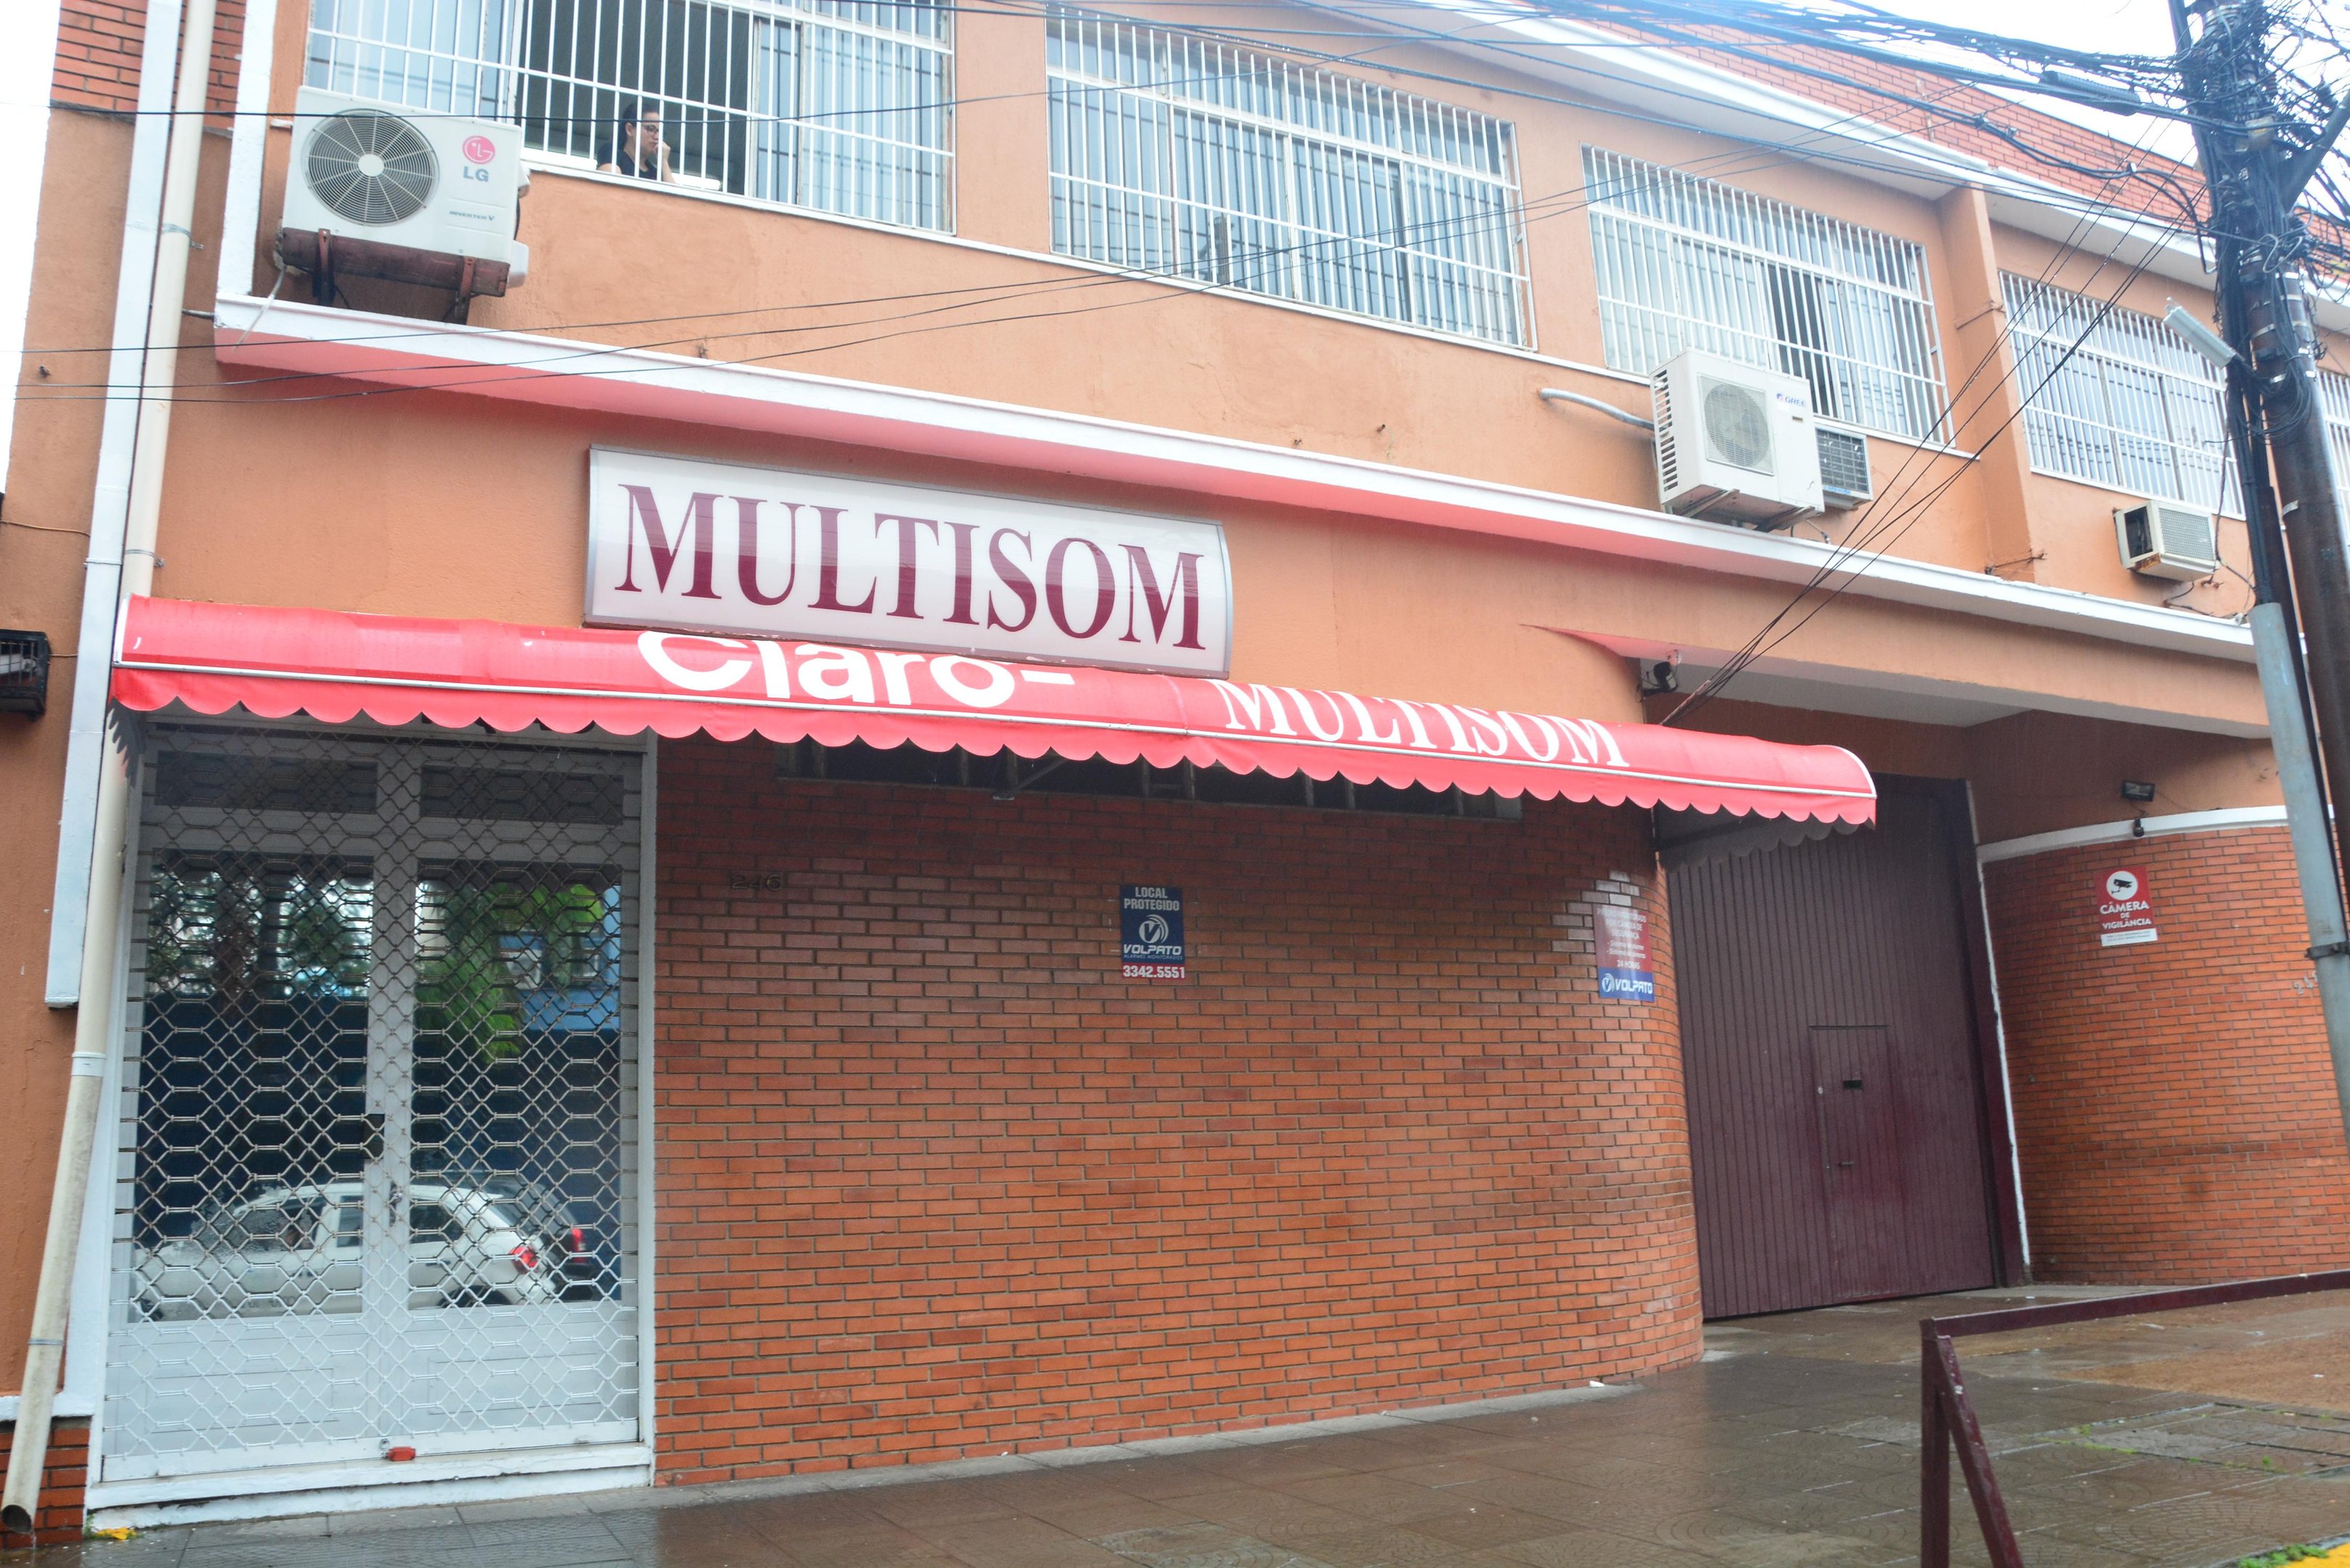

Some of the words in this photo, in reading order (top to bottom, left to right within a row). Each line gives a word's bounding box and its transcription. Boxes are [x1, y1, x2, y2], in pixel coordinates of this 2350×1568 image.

[463, 166, 489, 182] LG
[449, 211, 487, 220] INVERTER
[1785, 396, 1806, 407] GREE
[614, 483, 1207, 650] MULTISOM
[1198, 678, 1630, 768] MULTISOM
[1135, 887, 1167, 899] LOCAL
[1124, 898, 1180, 911] PROTEGIDO
[2100, 900, 2150, 915] CÂMERA
[2102, 918, 2152, 929] VIGILÂNCIA
[1123, 944, 1182, 955] VOLPATO
[1123, 965, 1185, 979] 3342.5551
[1614, 978, 1653, 995] VOLPATO
